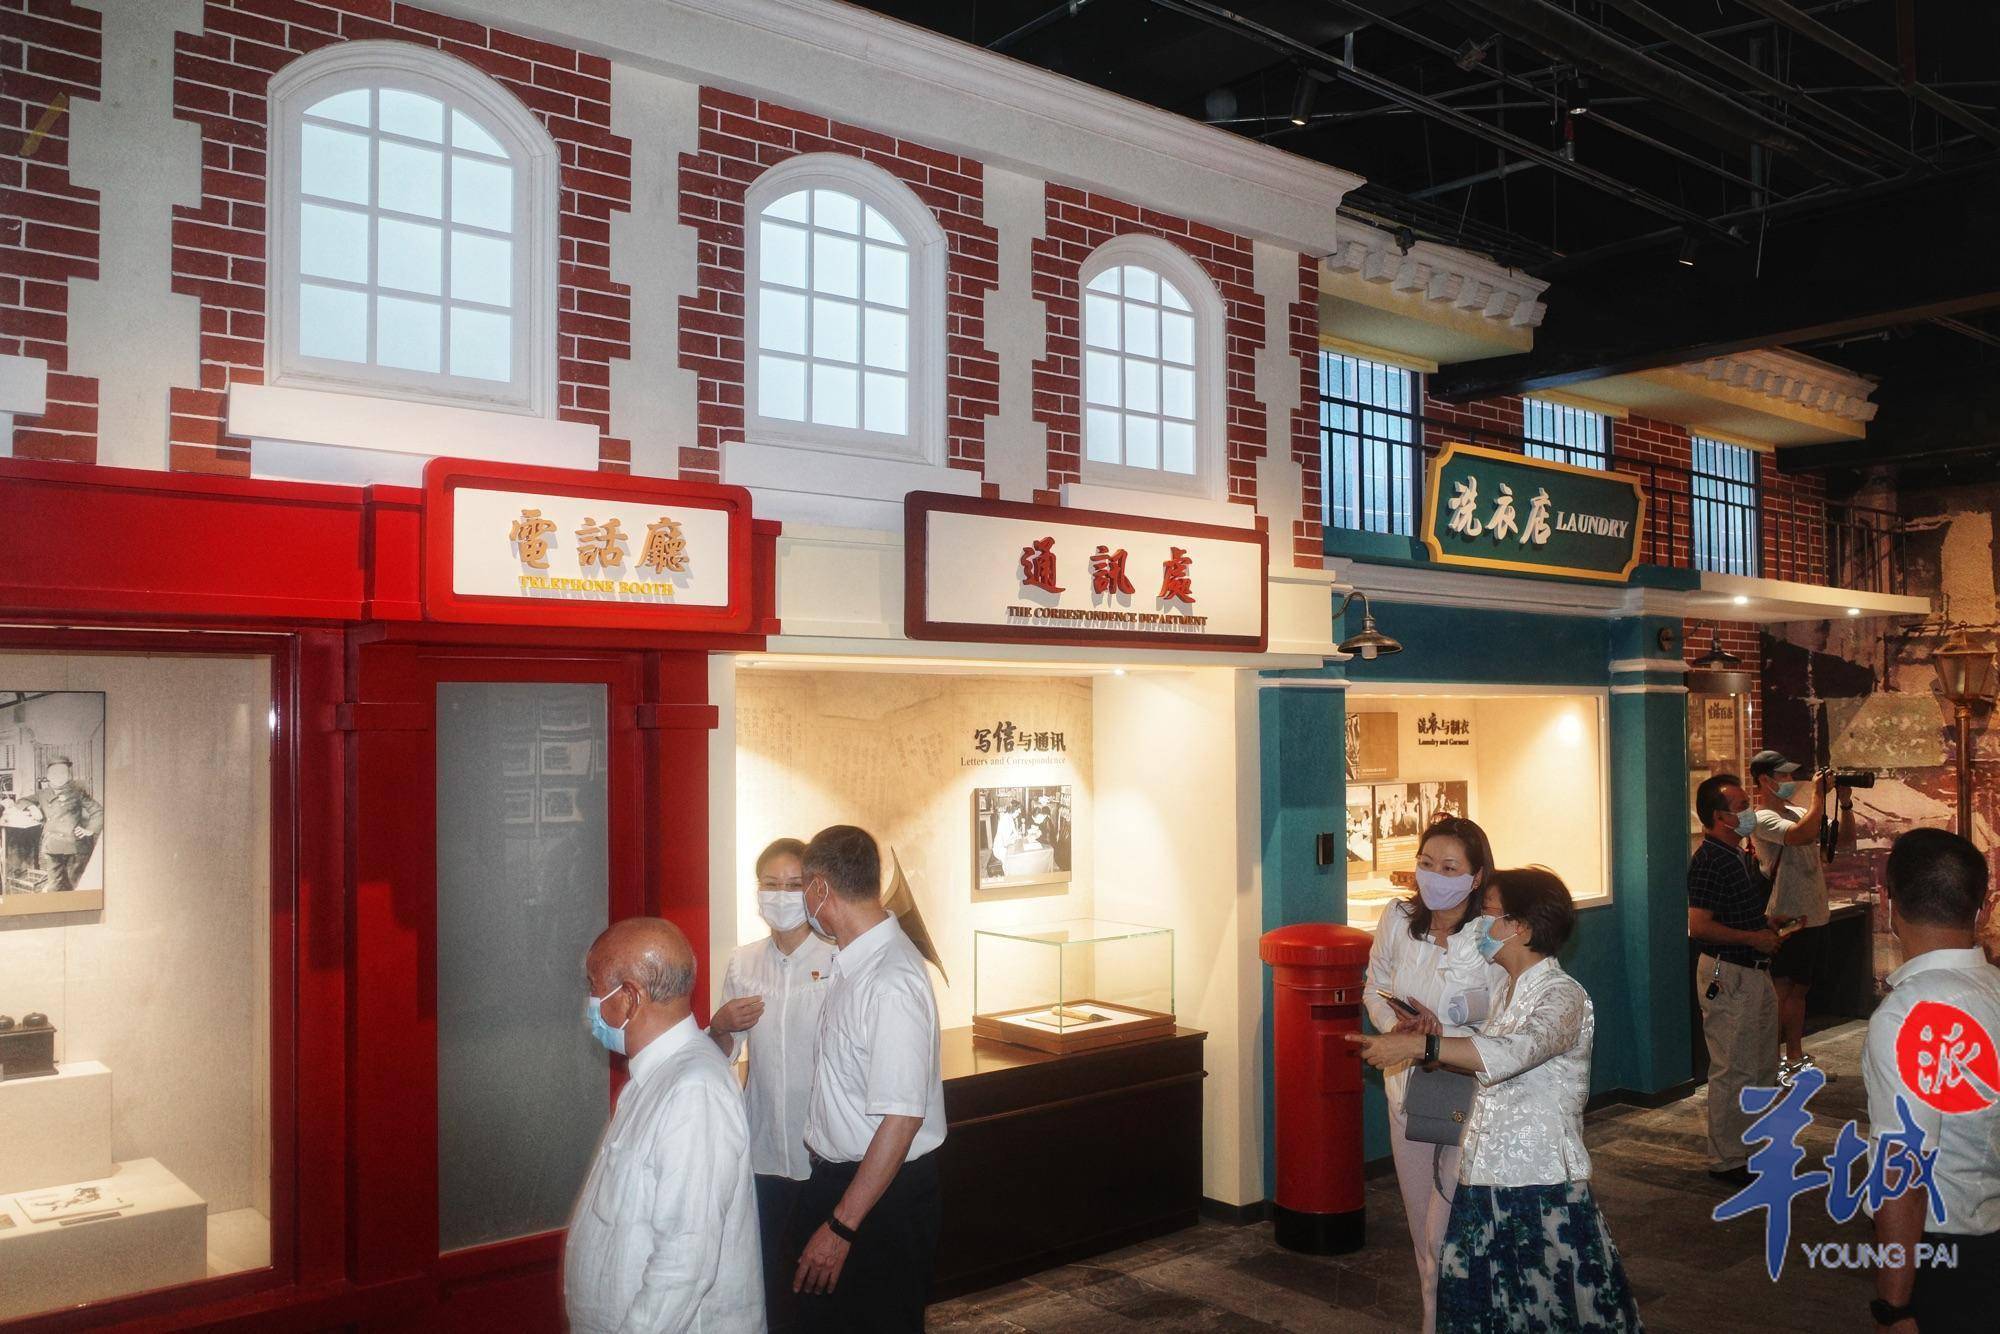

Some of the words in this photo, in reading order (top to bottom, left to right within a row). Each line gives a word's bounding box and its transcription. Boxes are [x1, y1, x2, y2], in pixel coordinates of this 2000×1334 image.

[1448, 475, 1552, 545] 洗衣店
[1555, 511, 1630, 539] LAUNDRY
[509, 508, 690, 574] 電話廳
[1020, 536, 1197, 604] 通訊處
[518, 575, 614, 593] TELEPHONE
[618, 581, 674, 596] BOOTH
[1007, 606, 1032, 618] THE
[1033, 608, 1137, 623] CORRESPONDENCE
[1138, 613, 1208, 626] DEPARTMENT
[974, 721, 1067, 753] 写信与通讯
[961, 757, 988, 766] Letters
